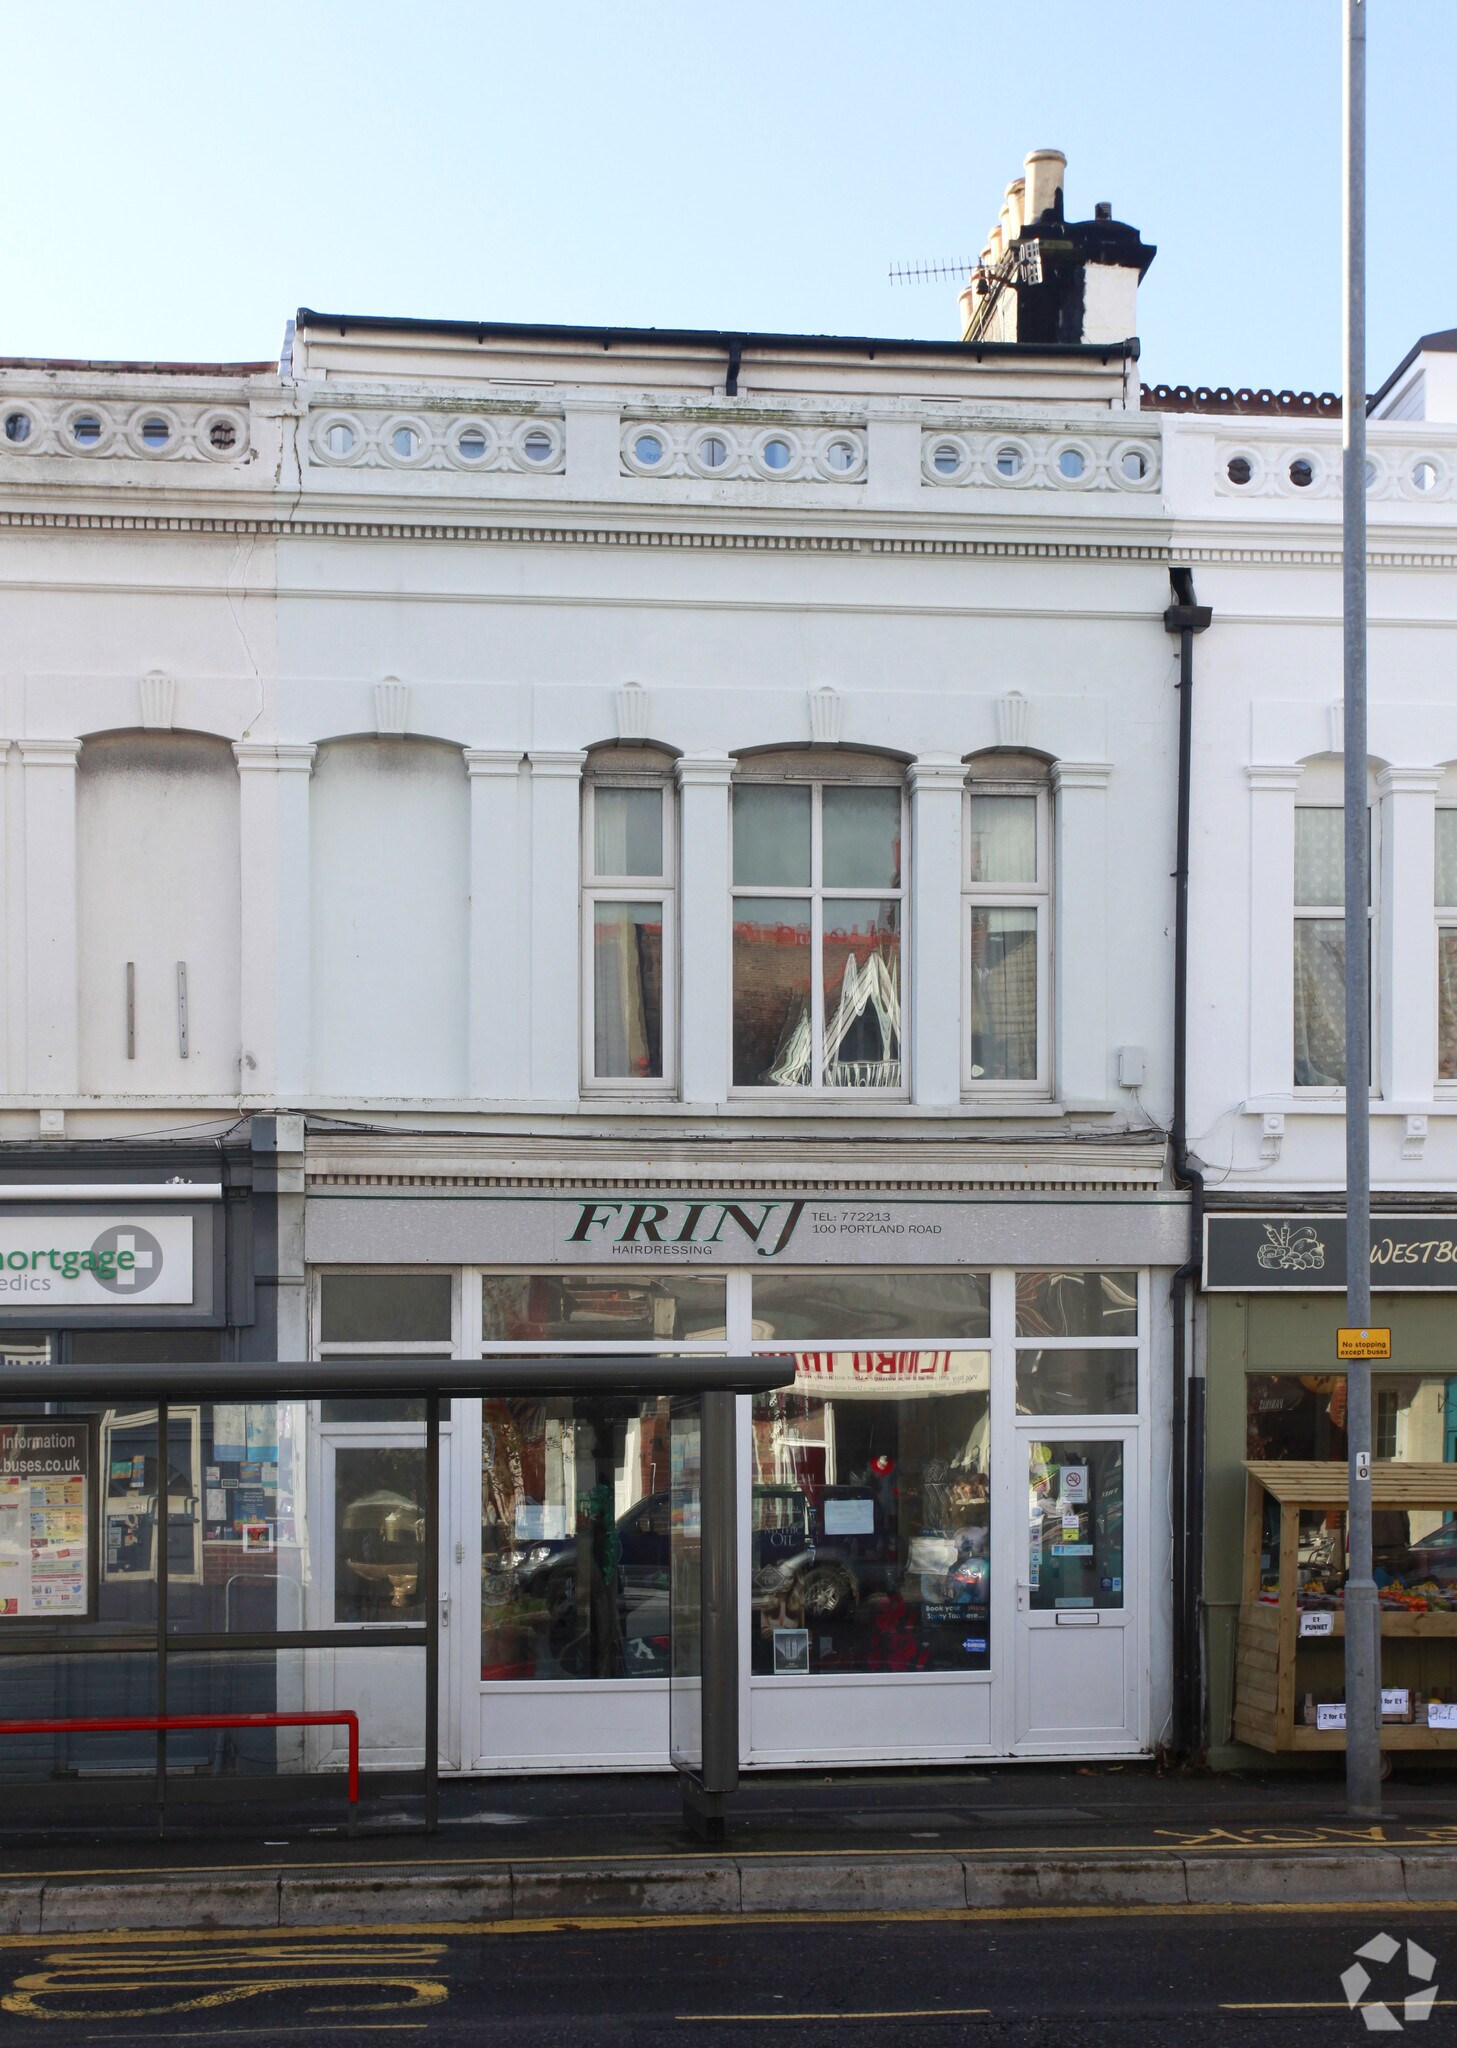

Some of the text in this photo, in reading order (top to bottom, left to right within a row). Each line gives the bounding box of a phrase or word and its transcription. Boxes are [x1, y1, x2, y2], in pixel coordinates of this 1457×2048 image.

[812, 1212, 891, 1221] TEL: 772213
[564, 1202, 805, 1257] FRINJ
[813, 1225, 942, 1234] 100 PORTLAND ROAD
[612, 1245, 712, 1255] HAIRDRESSING
[1355, 1341, 1386, 1349] stopping
[2, 1433, 75, 1449] Information
